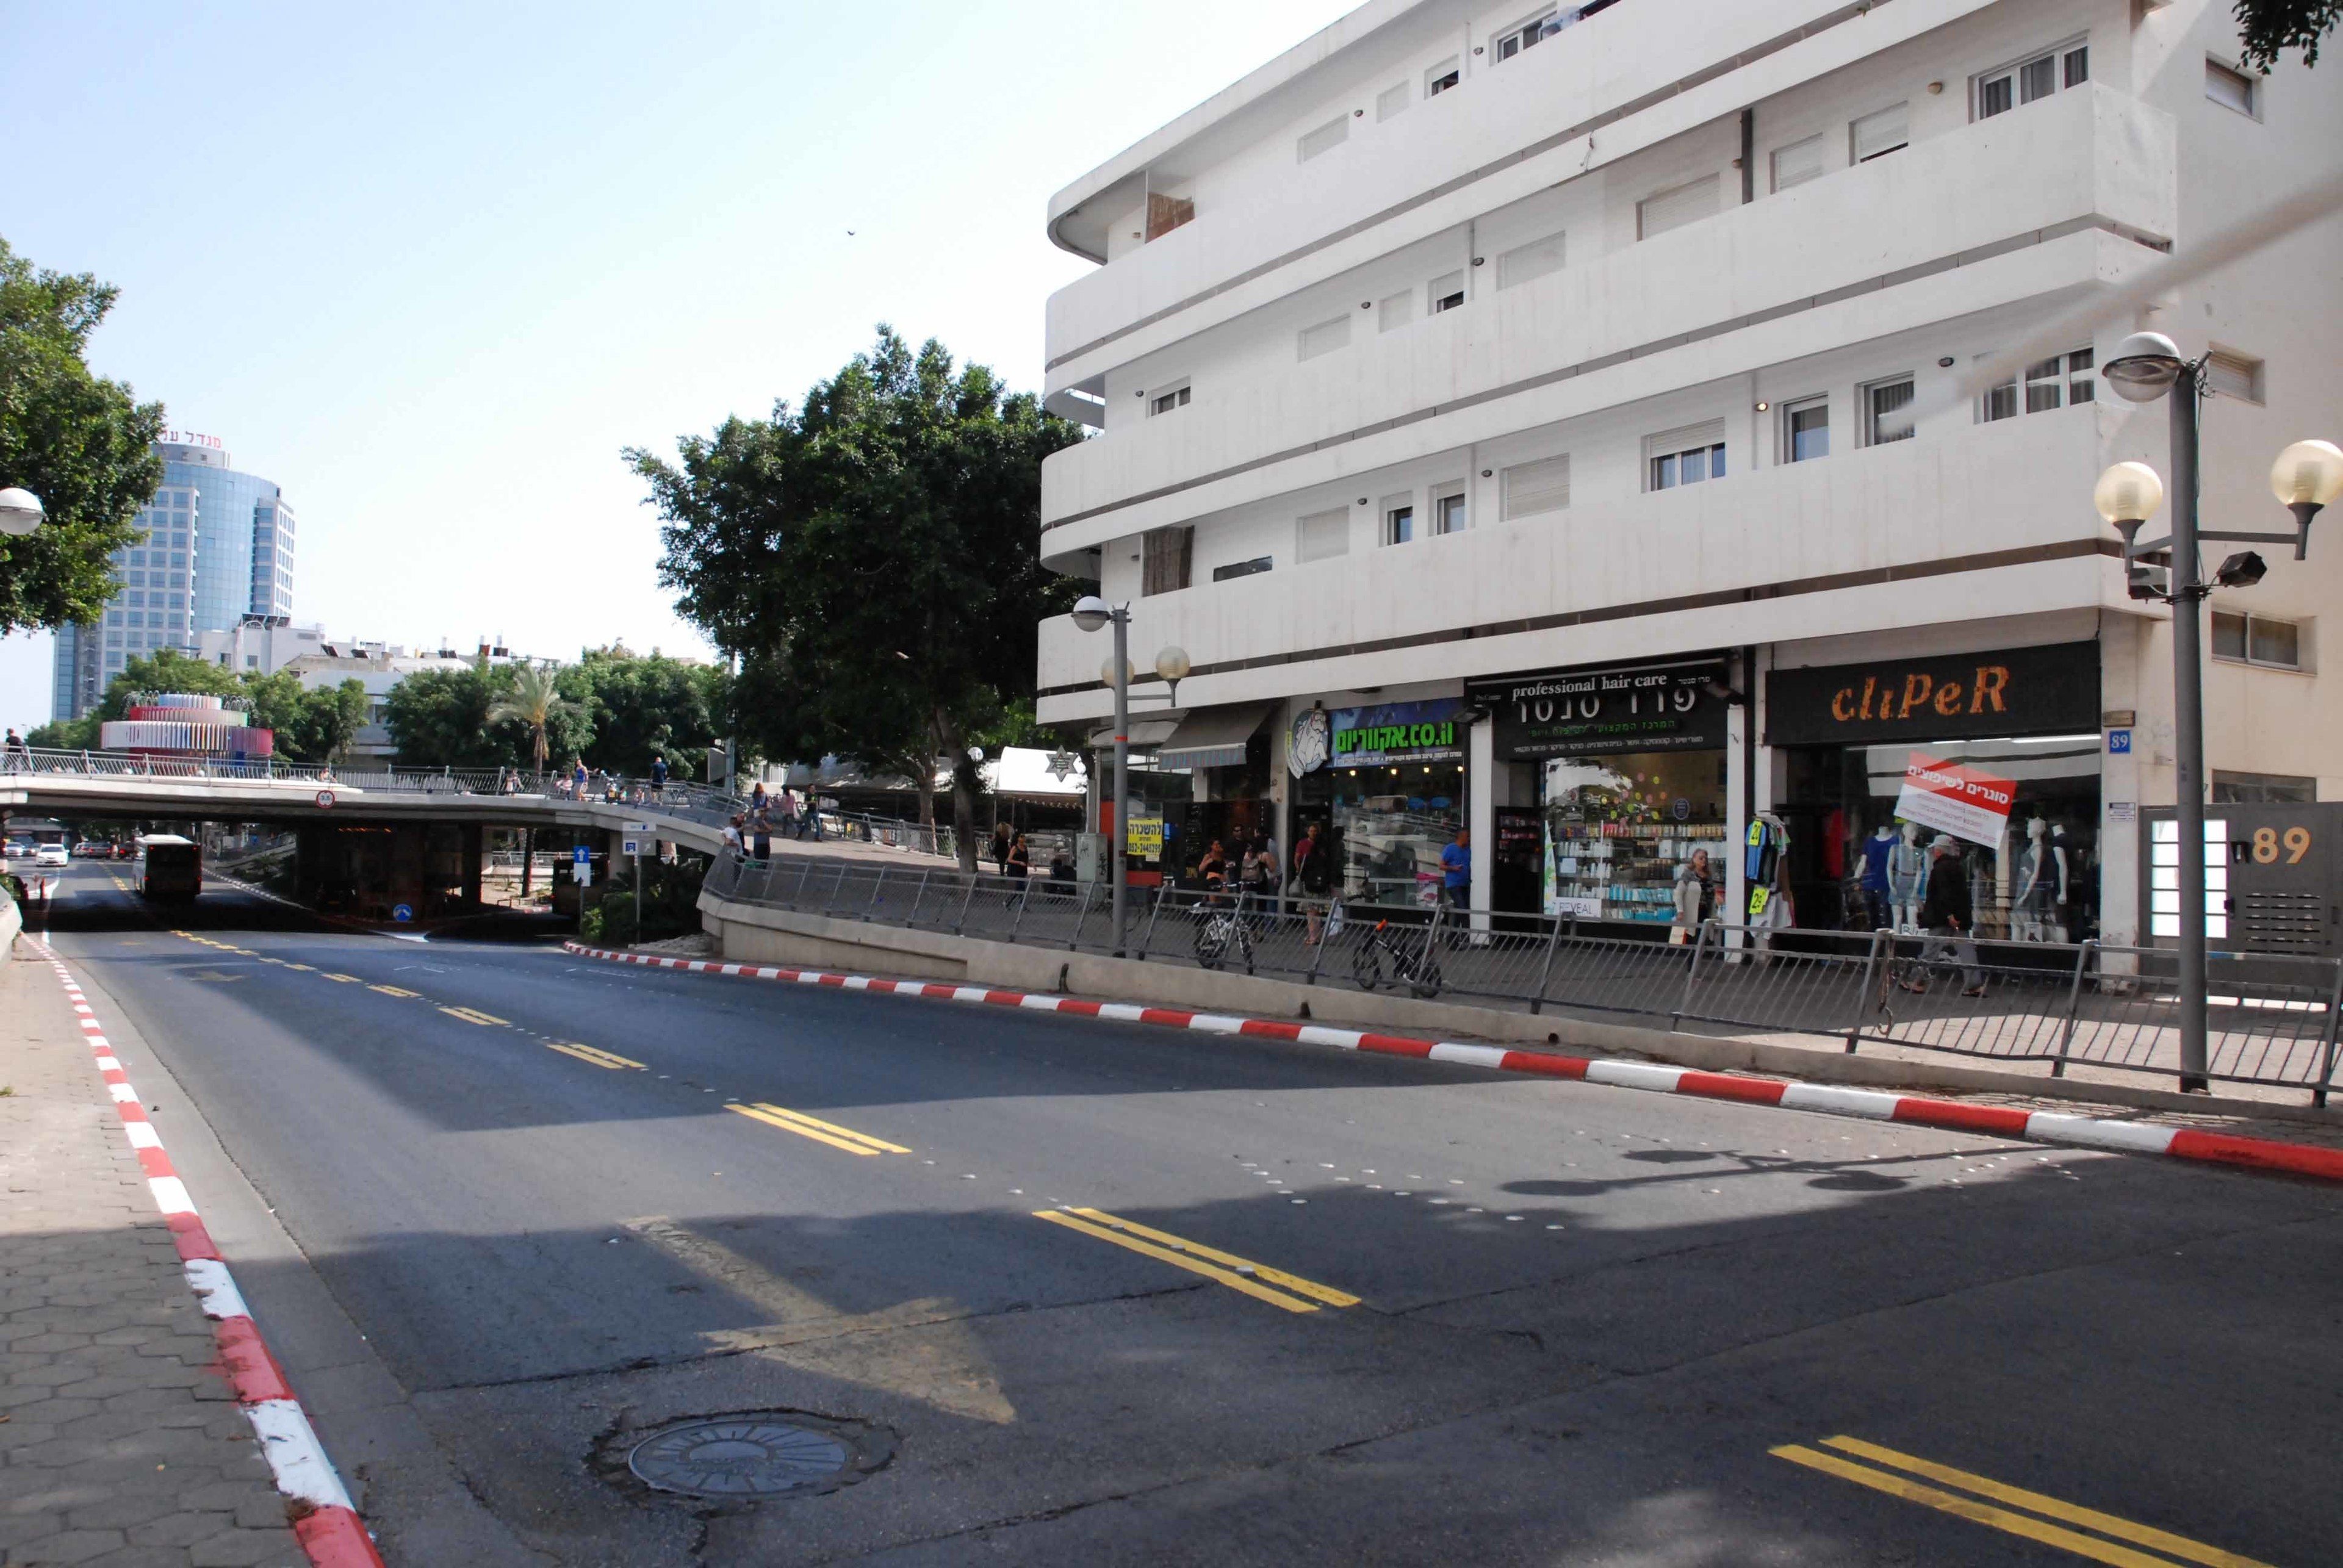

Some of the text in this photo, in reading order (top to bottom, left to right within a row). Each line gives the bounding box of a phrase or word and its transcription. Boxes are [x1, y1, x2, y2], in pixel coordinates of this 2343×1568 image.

[185, 431, 221, 448] מגדל
[1512, 674, 1667, 702] professional hair care
[2111, 735, 2128, 749] 89
[1908, 765, 2009, 804] סוגרים לשיפוצים
[1129, 822, 1162, 835] להשכרה
[2252, 827, 2311, 865] 89
